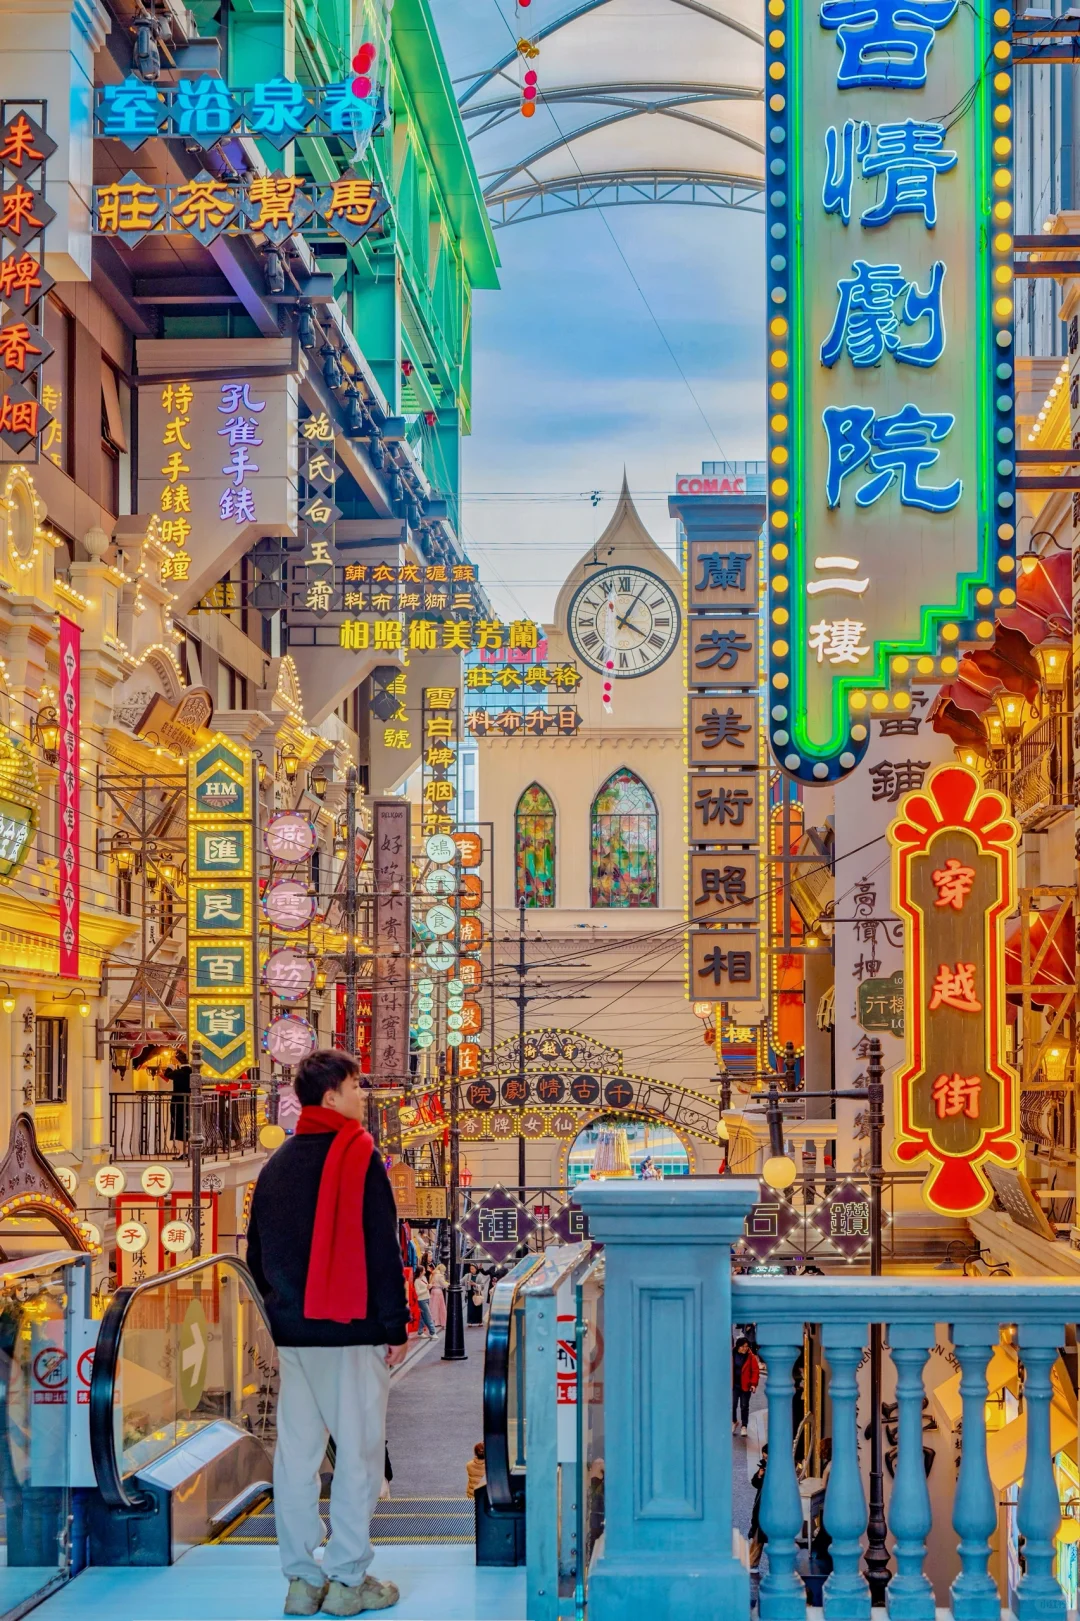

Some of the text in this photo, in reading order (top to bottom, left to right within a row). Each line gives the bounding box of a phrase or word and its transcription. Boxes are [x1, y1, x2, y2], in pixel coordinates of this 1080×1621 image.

[217, 383, 266, 524] 孔雀手錶
[304, 411, 335, 611] 施氏白玉霜
[677, 478, 744, 495] COMAC
[339, 620, 539, 650] 蘭芳美術照相
[806, 556, 870, 664] 二樓
[205, 782, 237, 796] HM
[695, 551, 752, 984] 蘭芳美術照相
[201, 836, 241, 1037] 匯民百貨
[929, 859, 981, 1120] 穿越街
[470, 1080, 630, 1104] 千古情劇院
